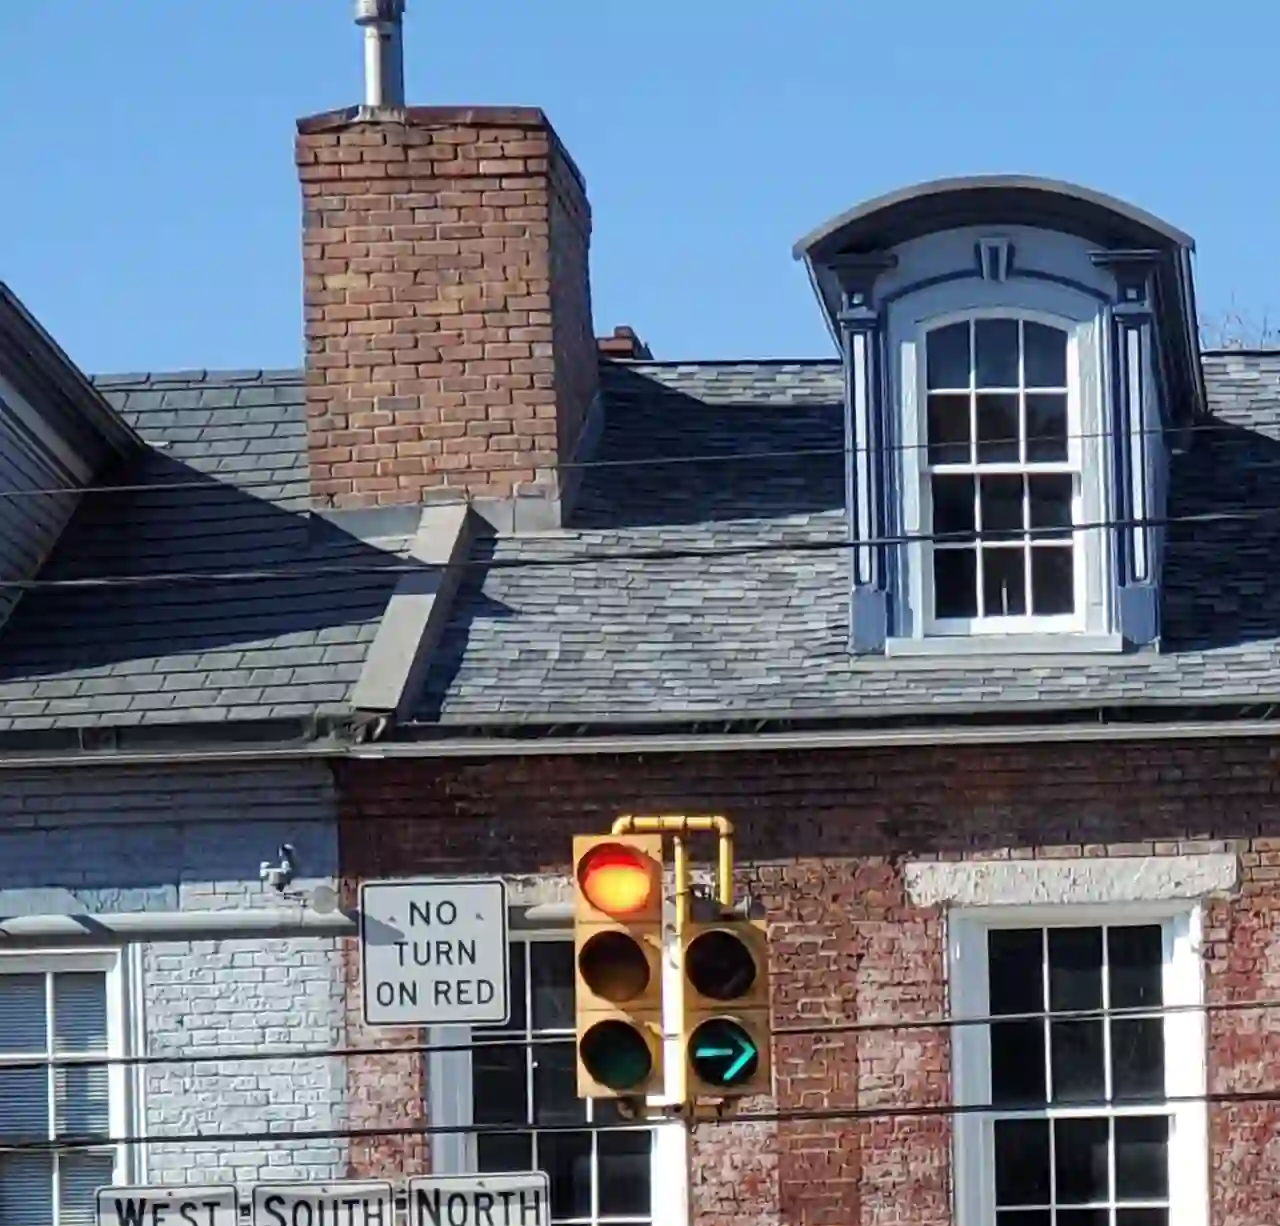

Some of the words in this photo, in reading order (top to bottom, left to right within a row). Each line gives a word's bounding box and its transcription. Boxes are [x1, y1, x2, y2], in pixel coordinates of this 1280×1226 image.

[409, 900, 458, 927] NO
[393, 939, 477, 967] TURN
[376, 980, 418, 1007] ON
[433, 979, 495, 1006] RED
